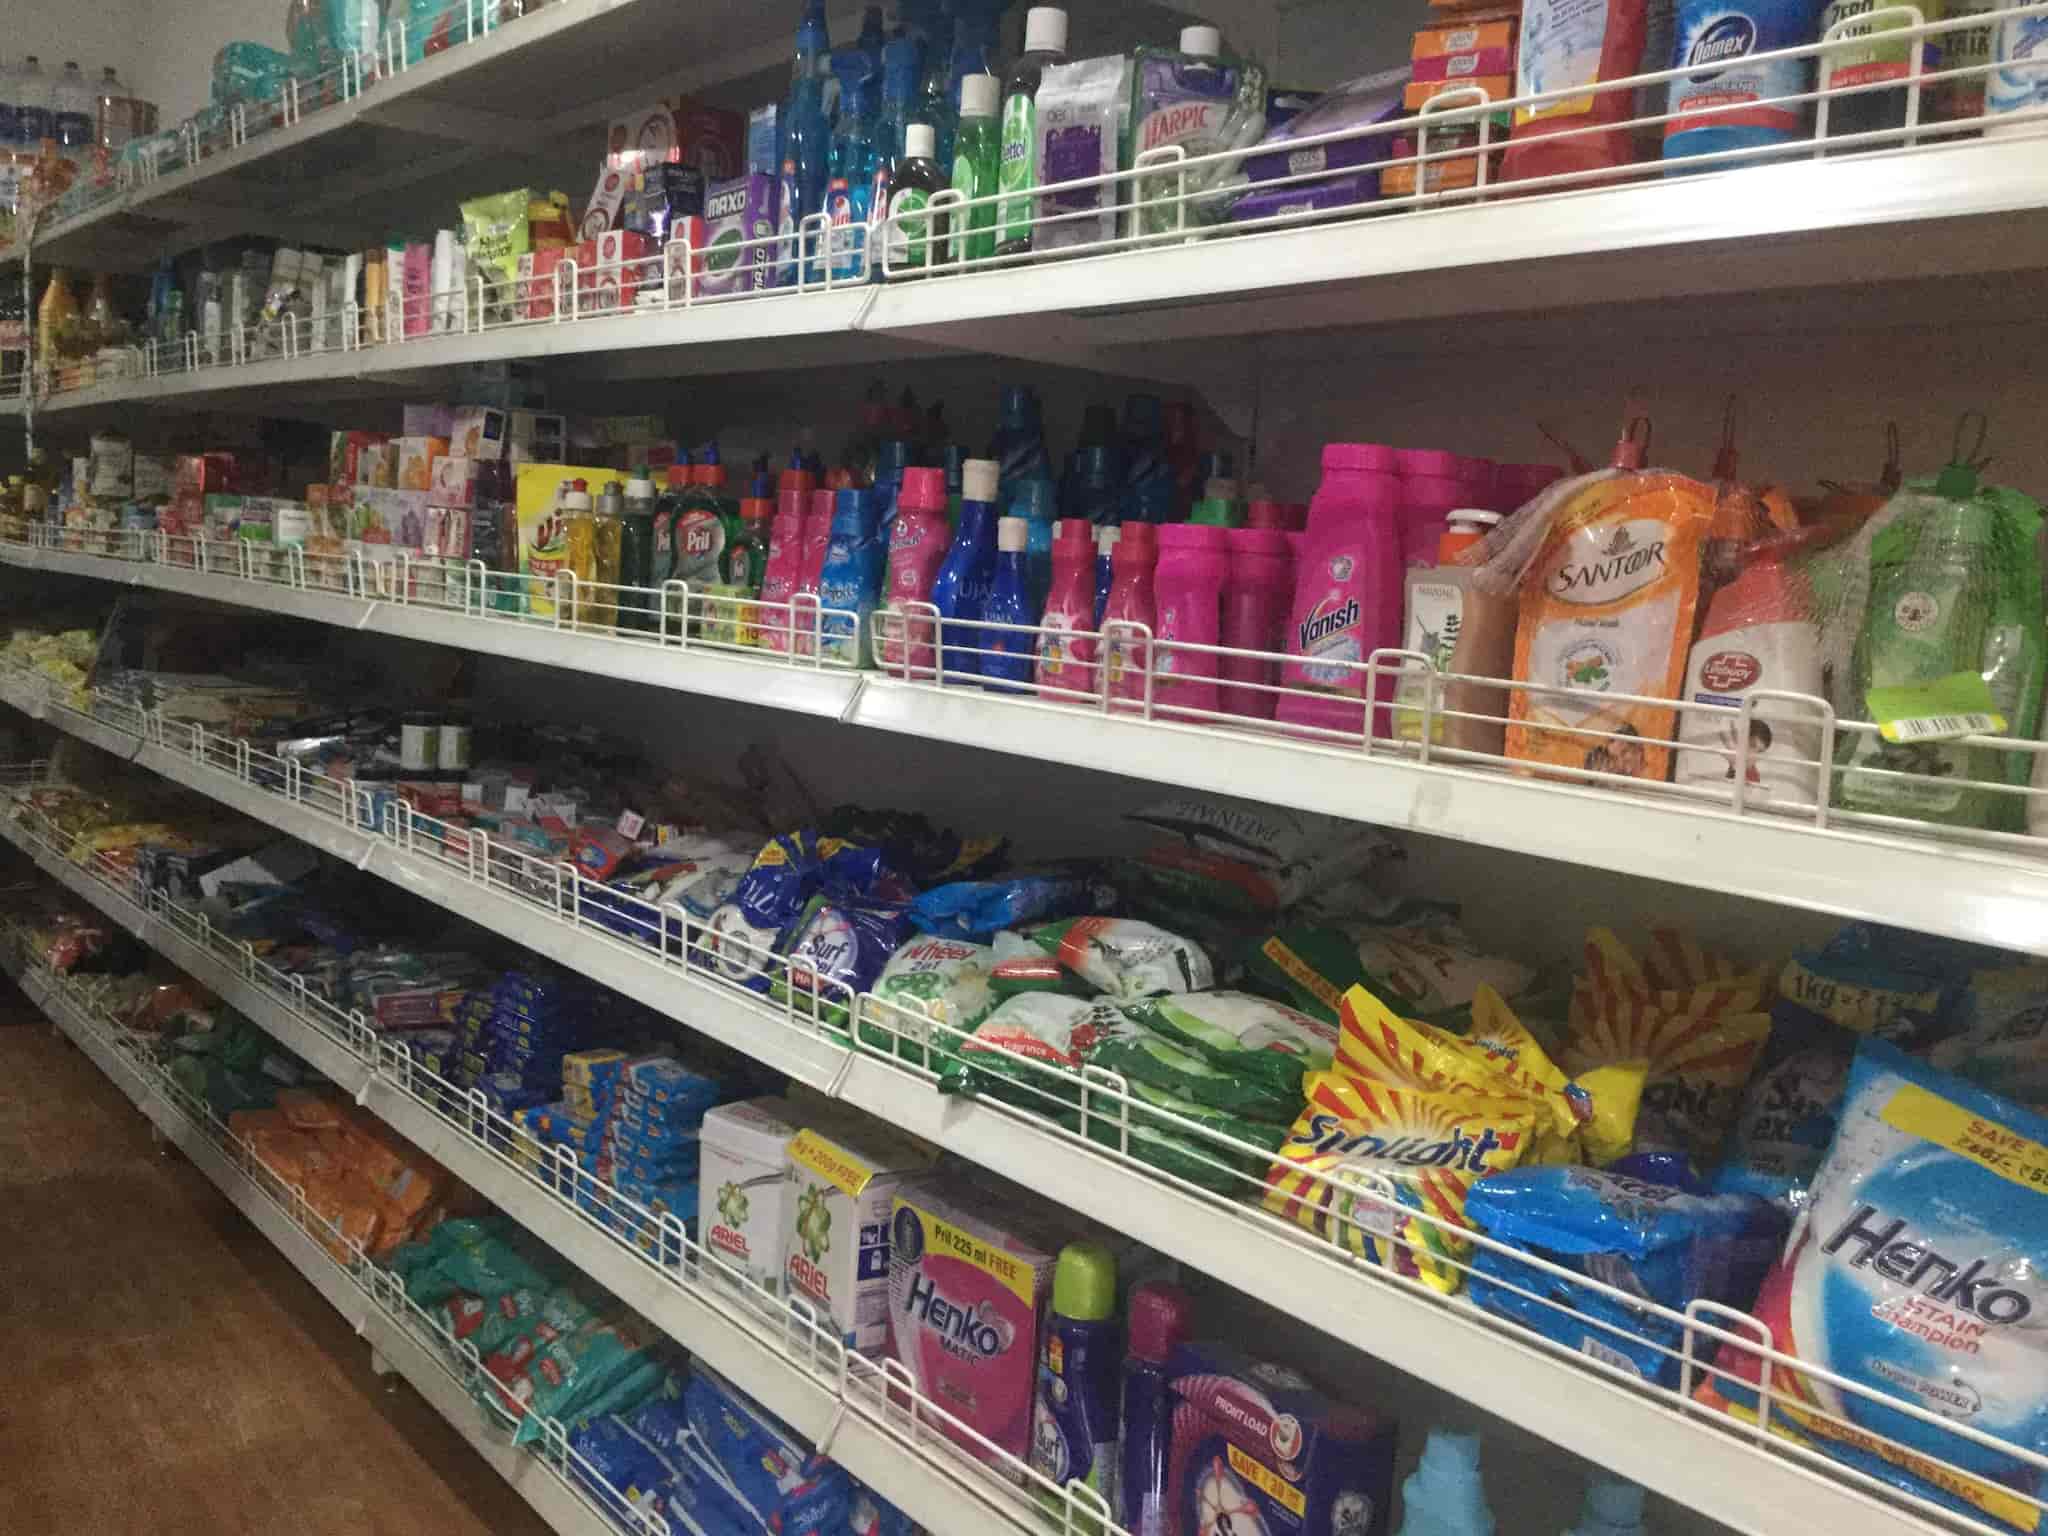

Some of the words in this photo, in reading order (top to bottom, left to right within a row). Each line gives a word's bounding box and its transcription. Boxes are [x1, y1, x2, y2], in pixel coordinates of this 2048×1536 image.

[1145, 104, 1210, 150] HARPIC
[707, 189, 747, 219] MAXO
[687, 530, 711, 552] Pril
[1556, 540, 1667, 593] SANTOOR
[1300, 597, 1360, 650] Vanish
[806, 934, 849, 961] Surf
[711, 1224, 751, 1253] ARIEL
[935, 1223, 952, 1245] Pril
[952, 1234, 973, 1257] 225
[989, 1255, 1018, 1281] FREE
[790, 1253, 832, 1302] ARIEL
[1820, 1206, 2032, 1325] Henko
[904, 1272, 1000, 1356] Henko
[1903, 1297, 1985, 1337] STAIN
[1213, 1394, 1245, 1421] FRONT
[1243, 1413, 1269, 1438] LOAD
